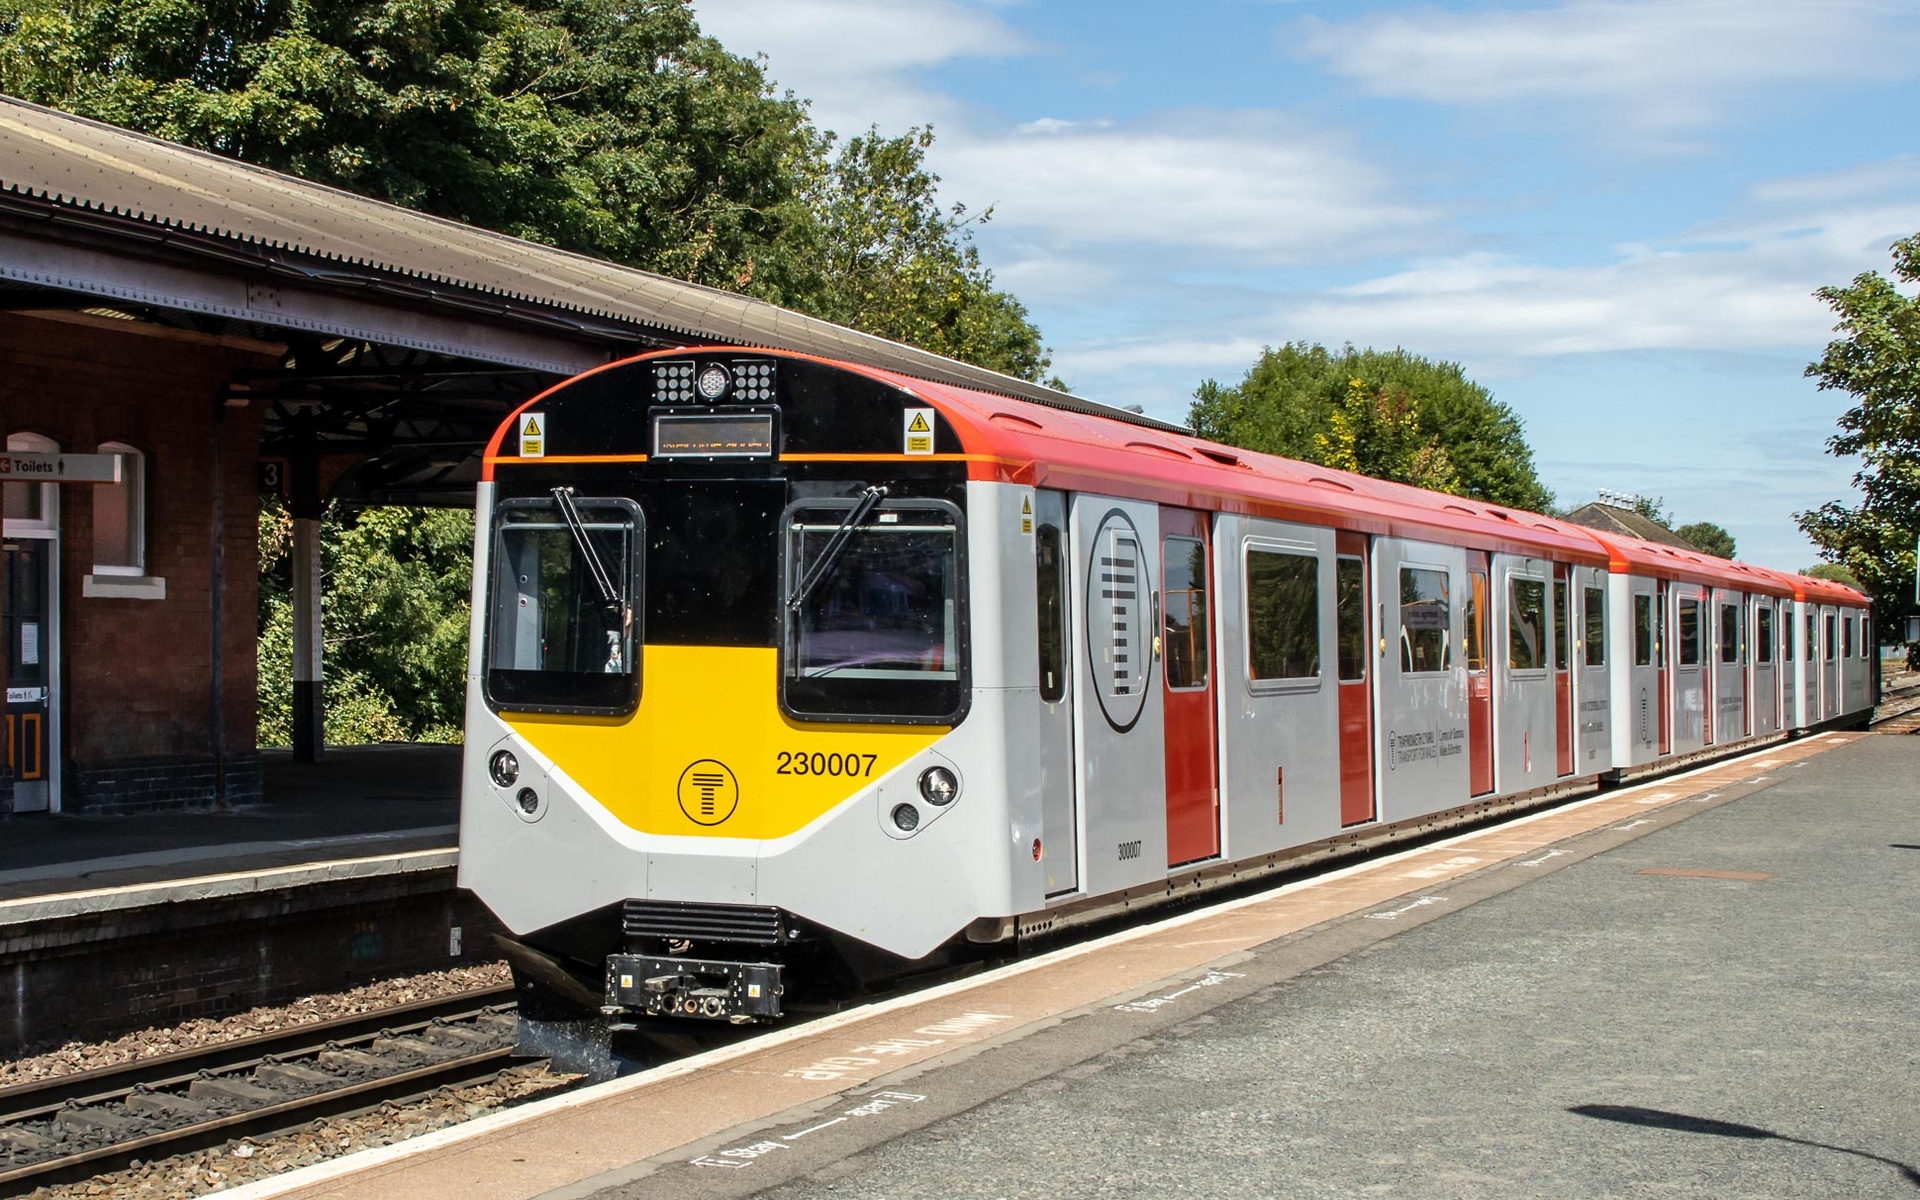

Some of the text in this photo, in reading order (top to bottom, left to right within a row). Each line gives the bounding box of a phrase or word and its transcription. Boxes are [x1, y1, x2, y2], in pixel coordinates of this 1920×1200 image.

[14, 460, 53, 473] Toilets
[264, 463, 278, 486] 3
[776, 751, 878, 777] 230007
[1118, 840, 1142, 861] 300007
